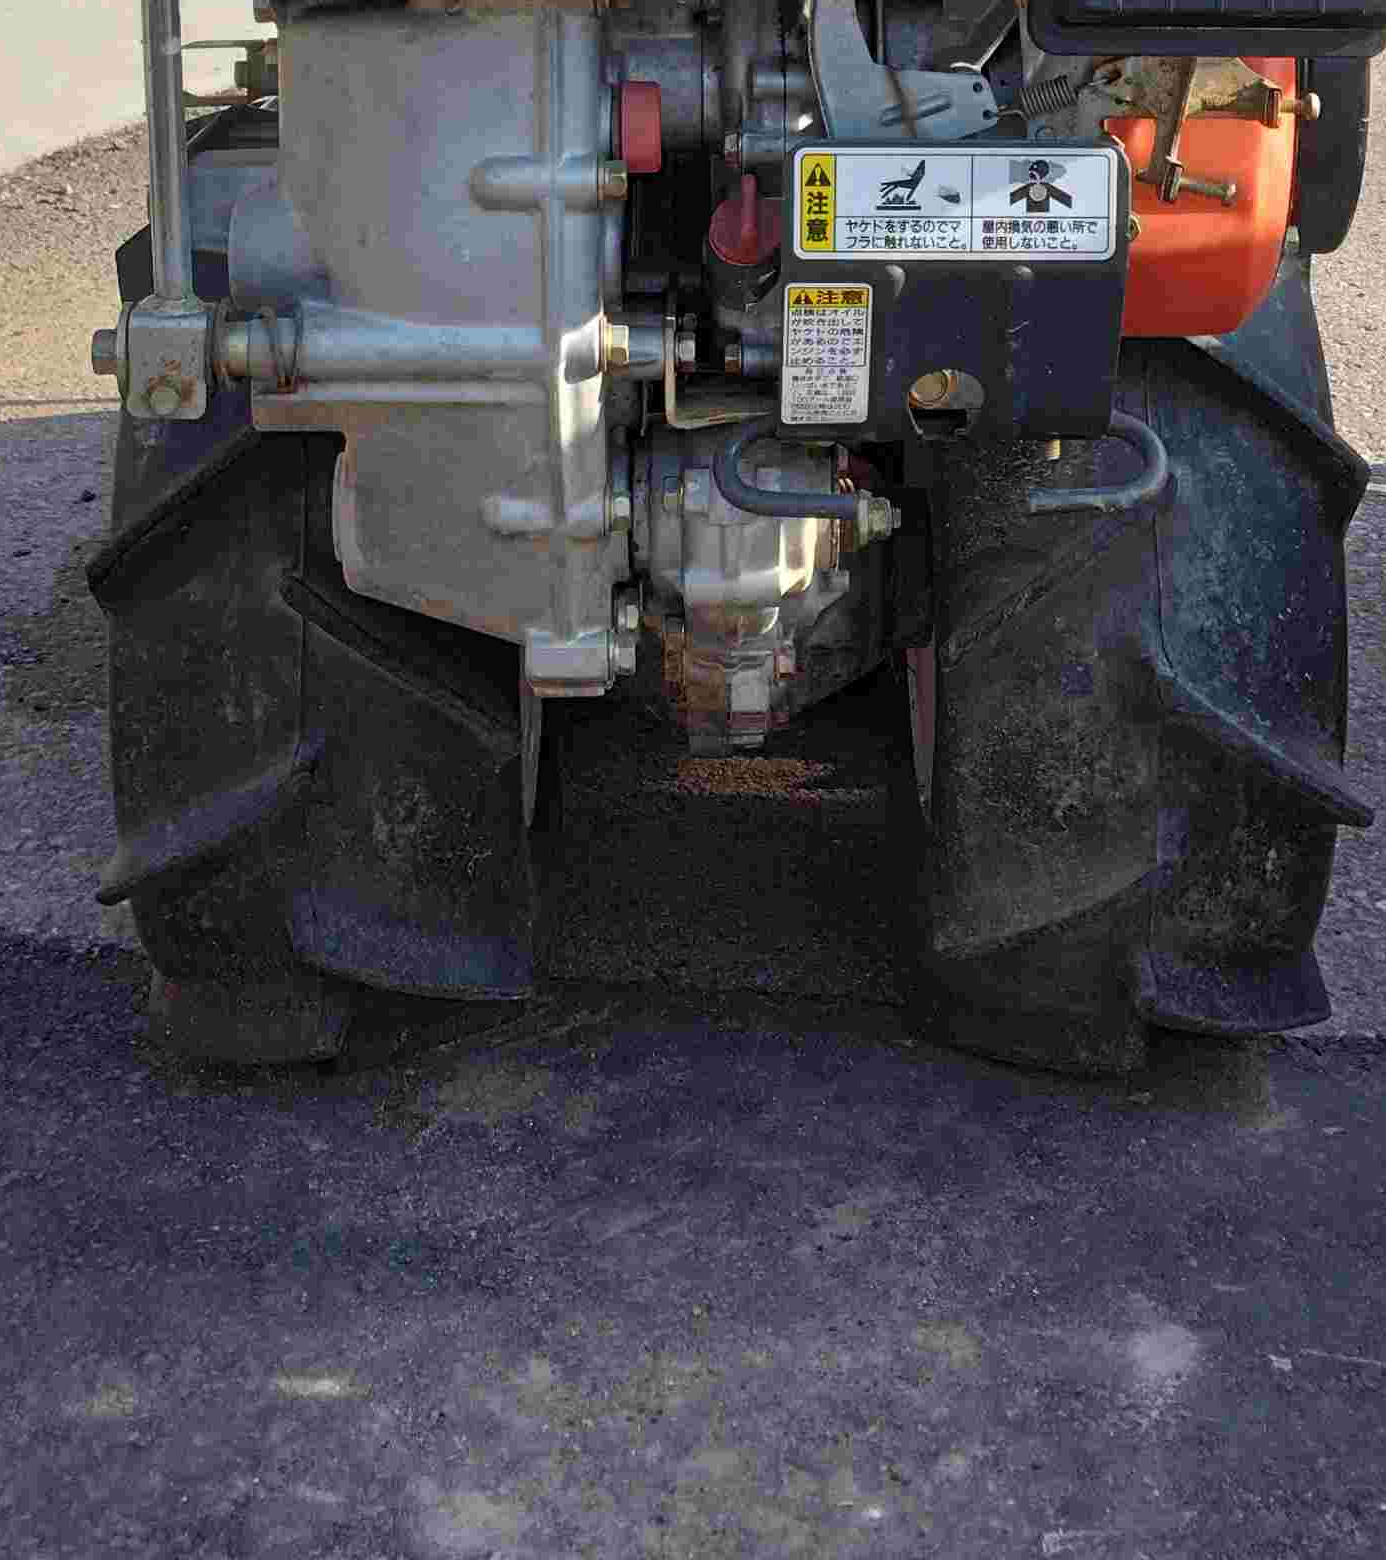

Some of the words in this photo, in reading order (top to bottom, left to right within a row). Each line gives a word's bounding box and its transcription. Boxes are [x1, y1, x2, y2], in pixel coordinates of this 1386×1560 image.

[806, 192, 829, 242] 注意
[845, 219, 962, 233] ヤケドをするのでマ
[845, 235, 967, 249] フラに触れないこと。
[981, 235, 1078, 249] 使用しないこと。
[817, 289, 864, 305] 注意
